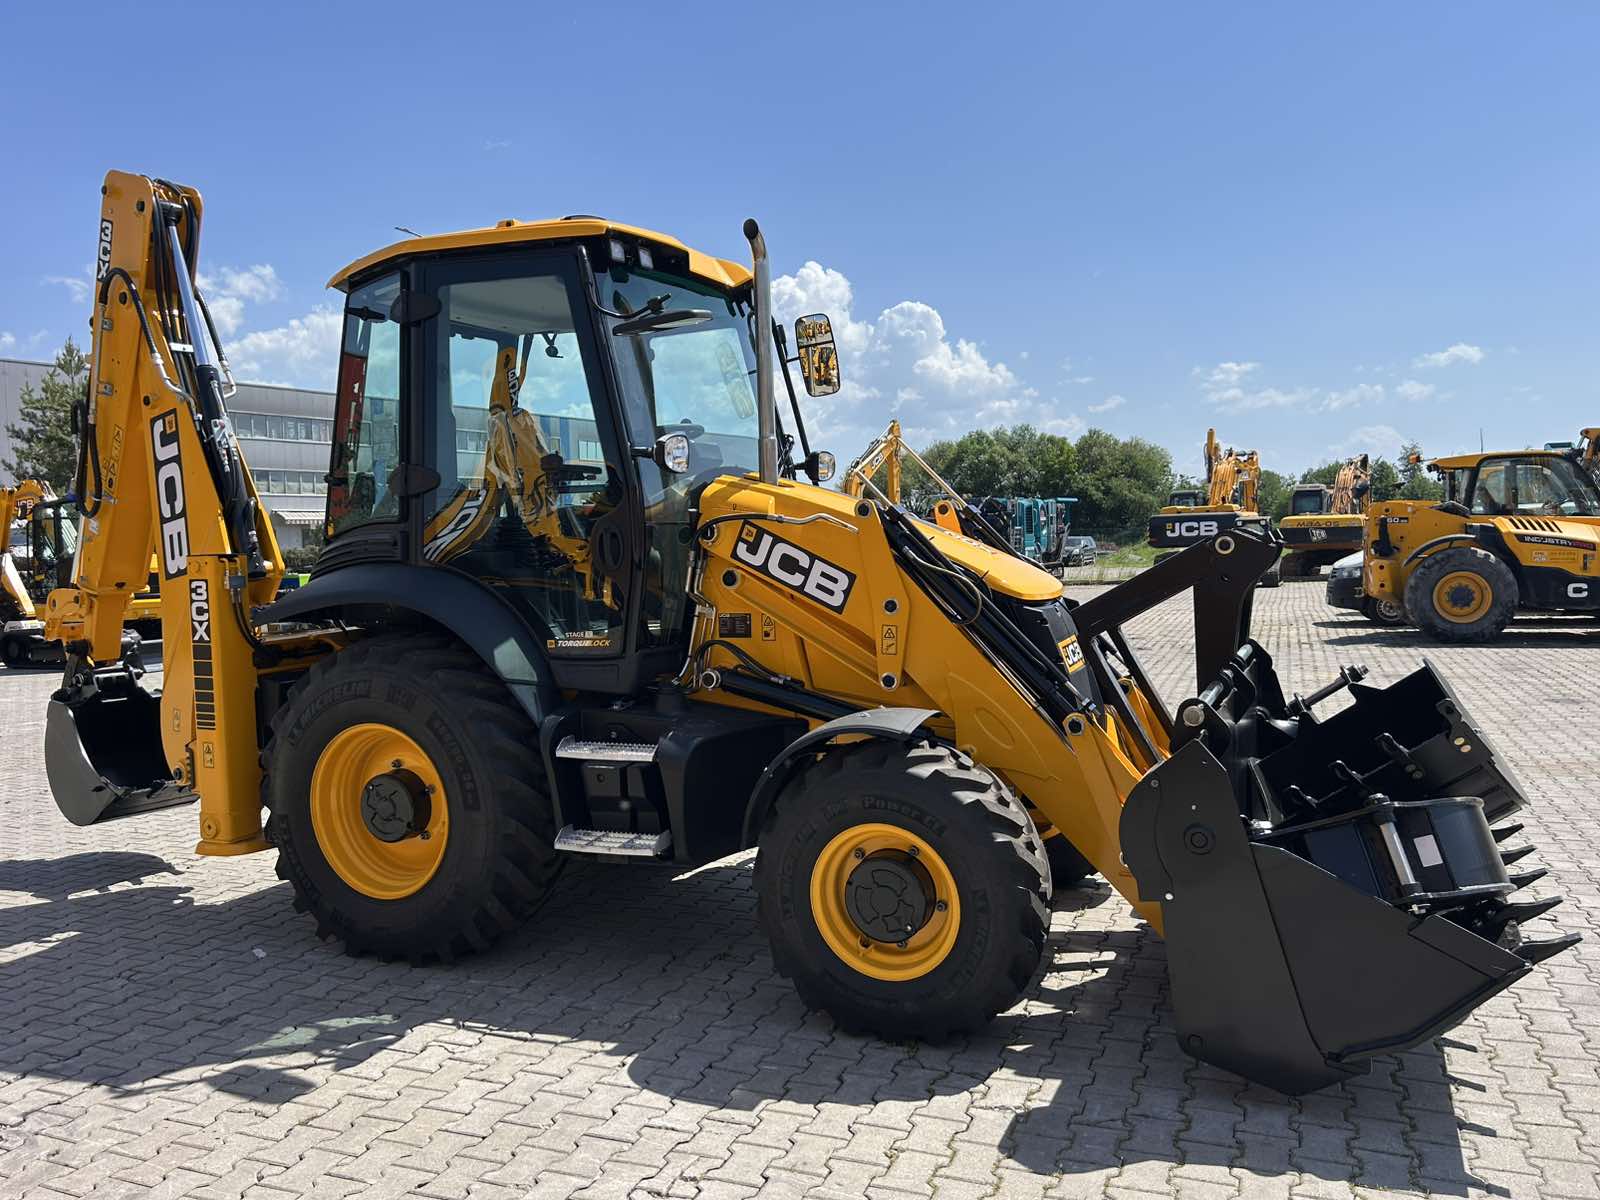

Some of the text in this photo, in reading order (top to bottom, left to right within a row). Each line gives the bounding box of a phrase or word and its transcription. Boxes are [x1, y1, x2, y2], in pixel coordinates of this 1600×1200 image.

[98, 221, 111, 279] 3CX
[152, 418, 187, 575] JCB
[1166, 521, 1218, 537] JCB
[736, 533, 849, 607] JCB
[190, 580, 210, 642] 3CX
[1065, 640, 1085, 667] JCB
